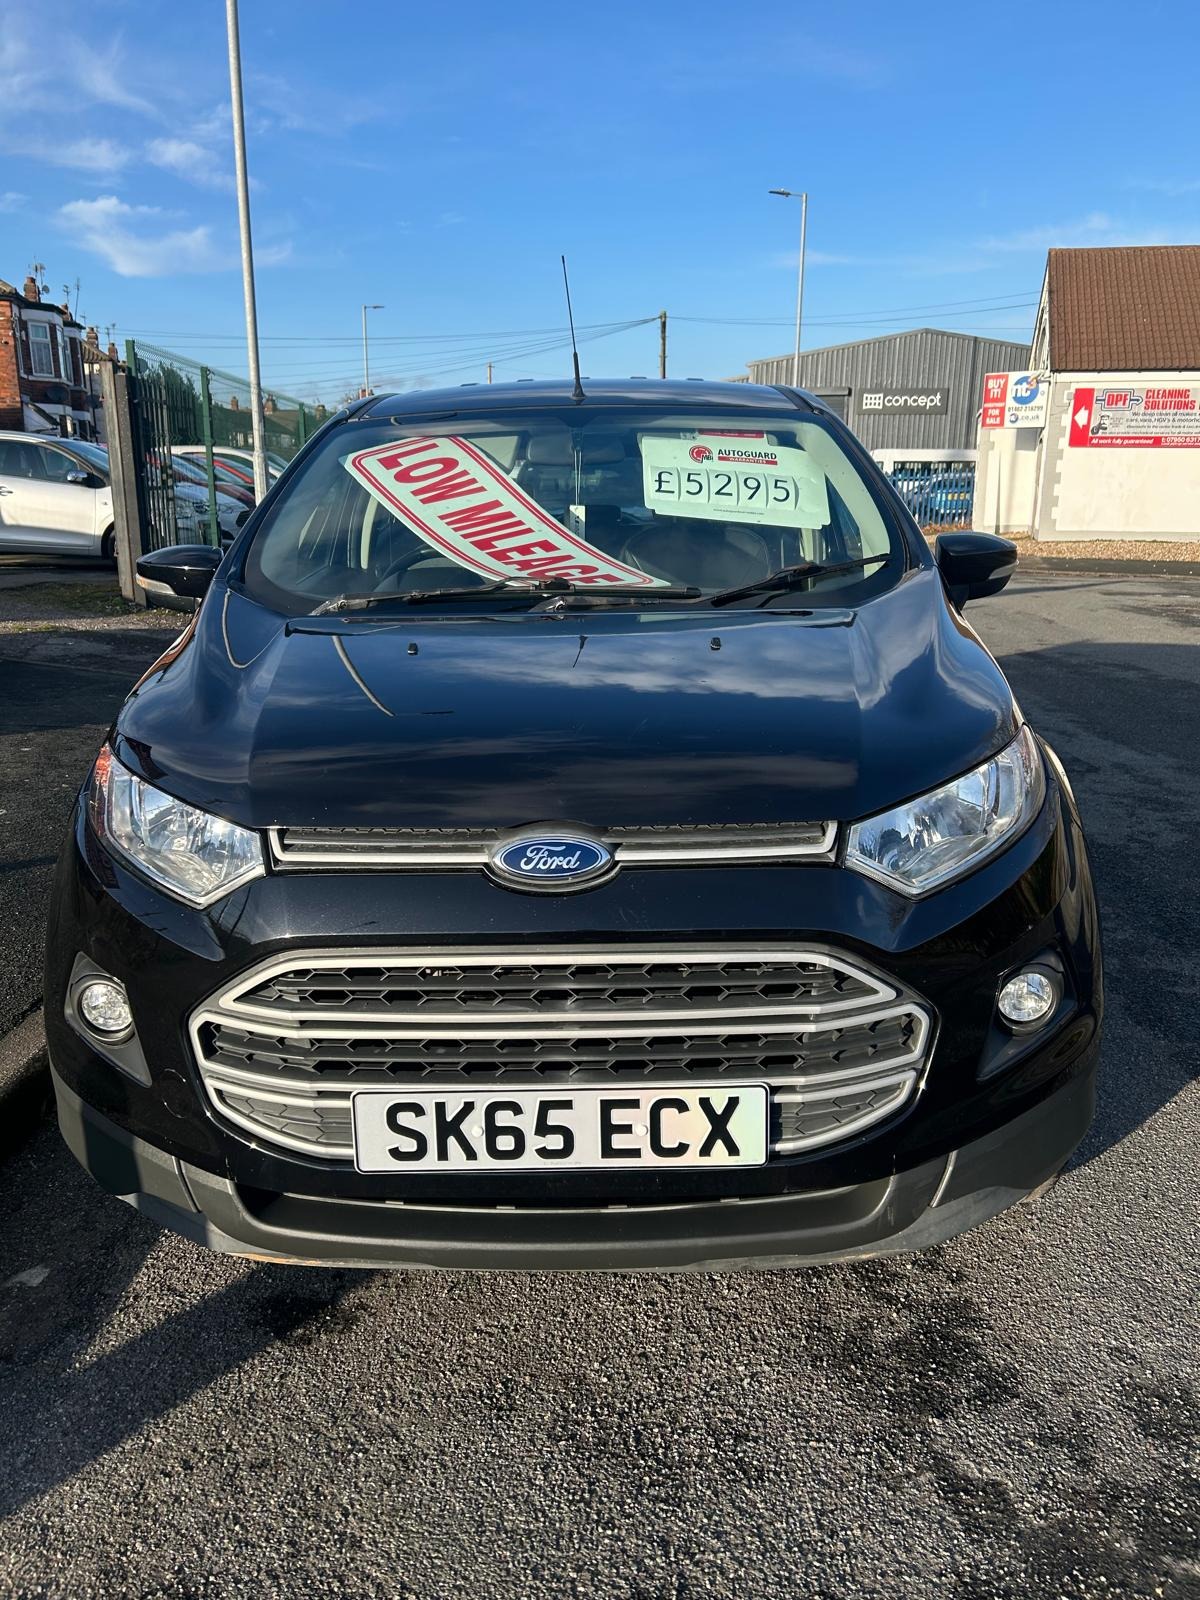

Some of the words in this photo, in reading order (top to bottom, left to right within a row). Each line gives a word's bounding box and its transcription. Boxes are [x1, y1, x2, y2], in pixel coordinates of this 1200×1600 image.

[988, 378, 1005, 389] BUY
[1106, 393, 1129, 406] DPF
[1145, 389, 1190, 399] CLEANING
[884, 392, 941, 410] concept
[1144, 400, 1196, 410] SOLUTIONS
[988, 408, 1000, 416] FOR
[718, 449, 777, 460] AUTOGUARD
[729, 457, 767, 465] WARRANTIES
[377, 443, 487, 504] LOW
[654, 471, 790, 503] £5295
[438, 500, 625, 583] MILEAGE
[520, 845, 581, 870] Ford
[386, 1099, 575, 1161] SK65
[600, 1096, 741, 1159] ECX
